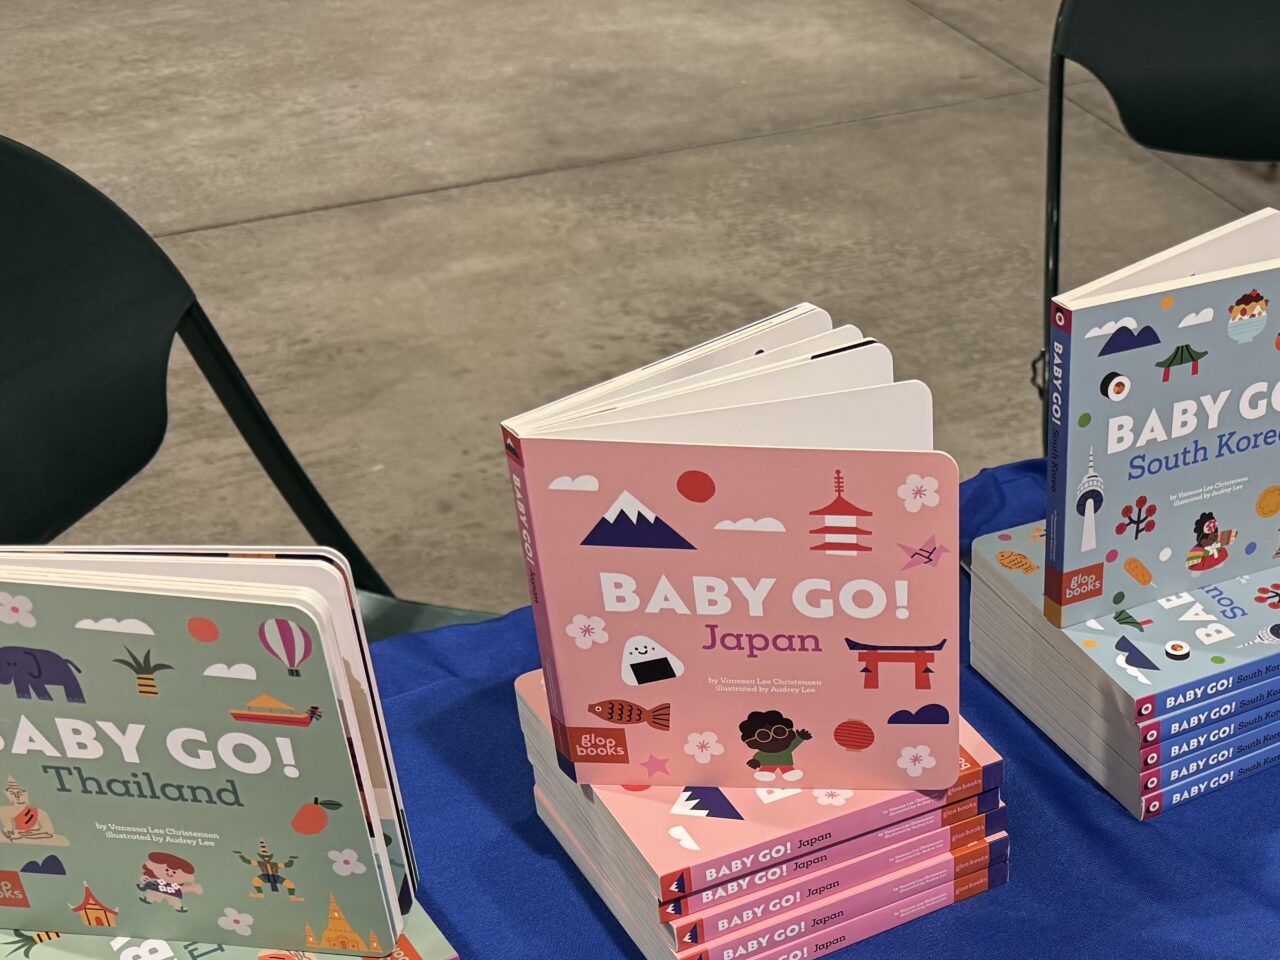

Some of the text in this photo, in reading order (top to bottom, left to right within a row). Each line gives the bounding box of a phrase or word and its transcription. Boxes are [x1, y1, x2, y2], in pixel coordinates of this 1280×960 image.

[1051, 340, 1063, 426] BABY GO!
[1107, 389, 1232, 455] BABY
[1127, 439, 1209, 481] South
[512, 474, 535, 565] BABY GO!
[600, 572, 909, 620] BABY GO!
[1066, 580, 1100, 598] books
[1071, 573, 1095, 589] glop
[702, 624, 822, 659] Japan
[1166, 686, 1205, 709] BABY
[1207, 677, 1233, 694] GO!
[1237, 670, 1263, 684] South
[1170, 712, 1208, 734] BABY
[1210, 702, 1236, 719] GO!
[1240, 694, 1265, 708] South
[0, 714, 300, 778] ABY GO!
[576, 745, 624, 755] books
[581, 733, 615, 747] glop
[1170, 735, 1207, 757] BABY
[1209, 724, 1234, 741] GO!
[1238, 716, 1263, 730] South
[1170, 759, 1206, 781] BABY
[1209, 748, 1233, 765] GO!
[1237, 740, 1262, 754] South
[43, 766, 244, 807] Thailand
[706, 832, 832, 881] BABY GO! Japan
[702, 854, 828, 903] BABY GO! Japan
[718, 881, 840, 932] BABY GO! Japan
[774, 922, 806, 942] GO!
[811, 910, 844, 927] Japan
[814, 935, 846, 952] Japan
